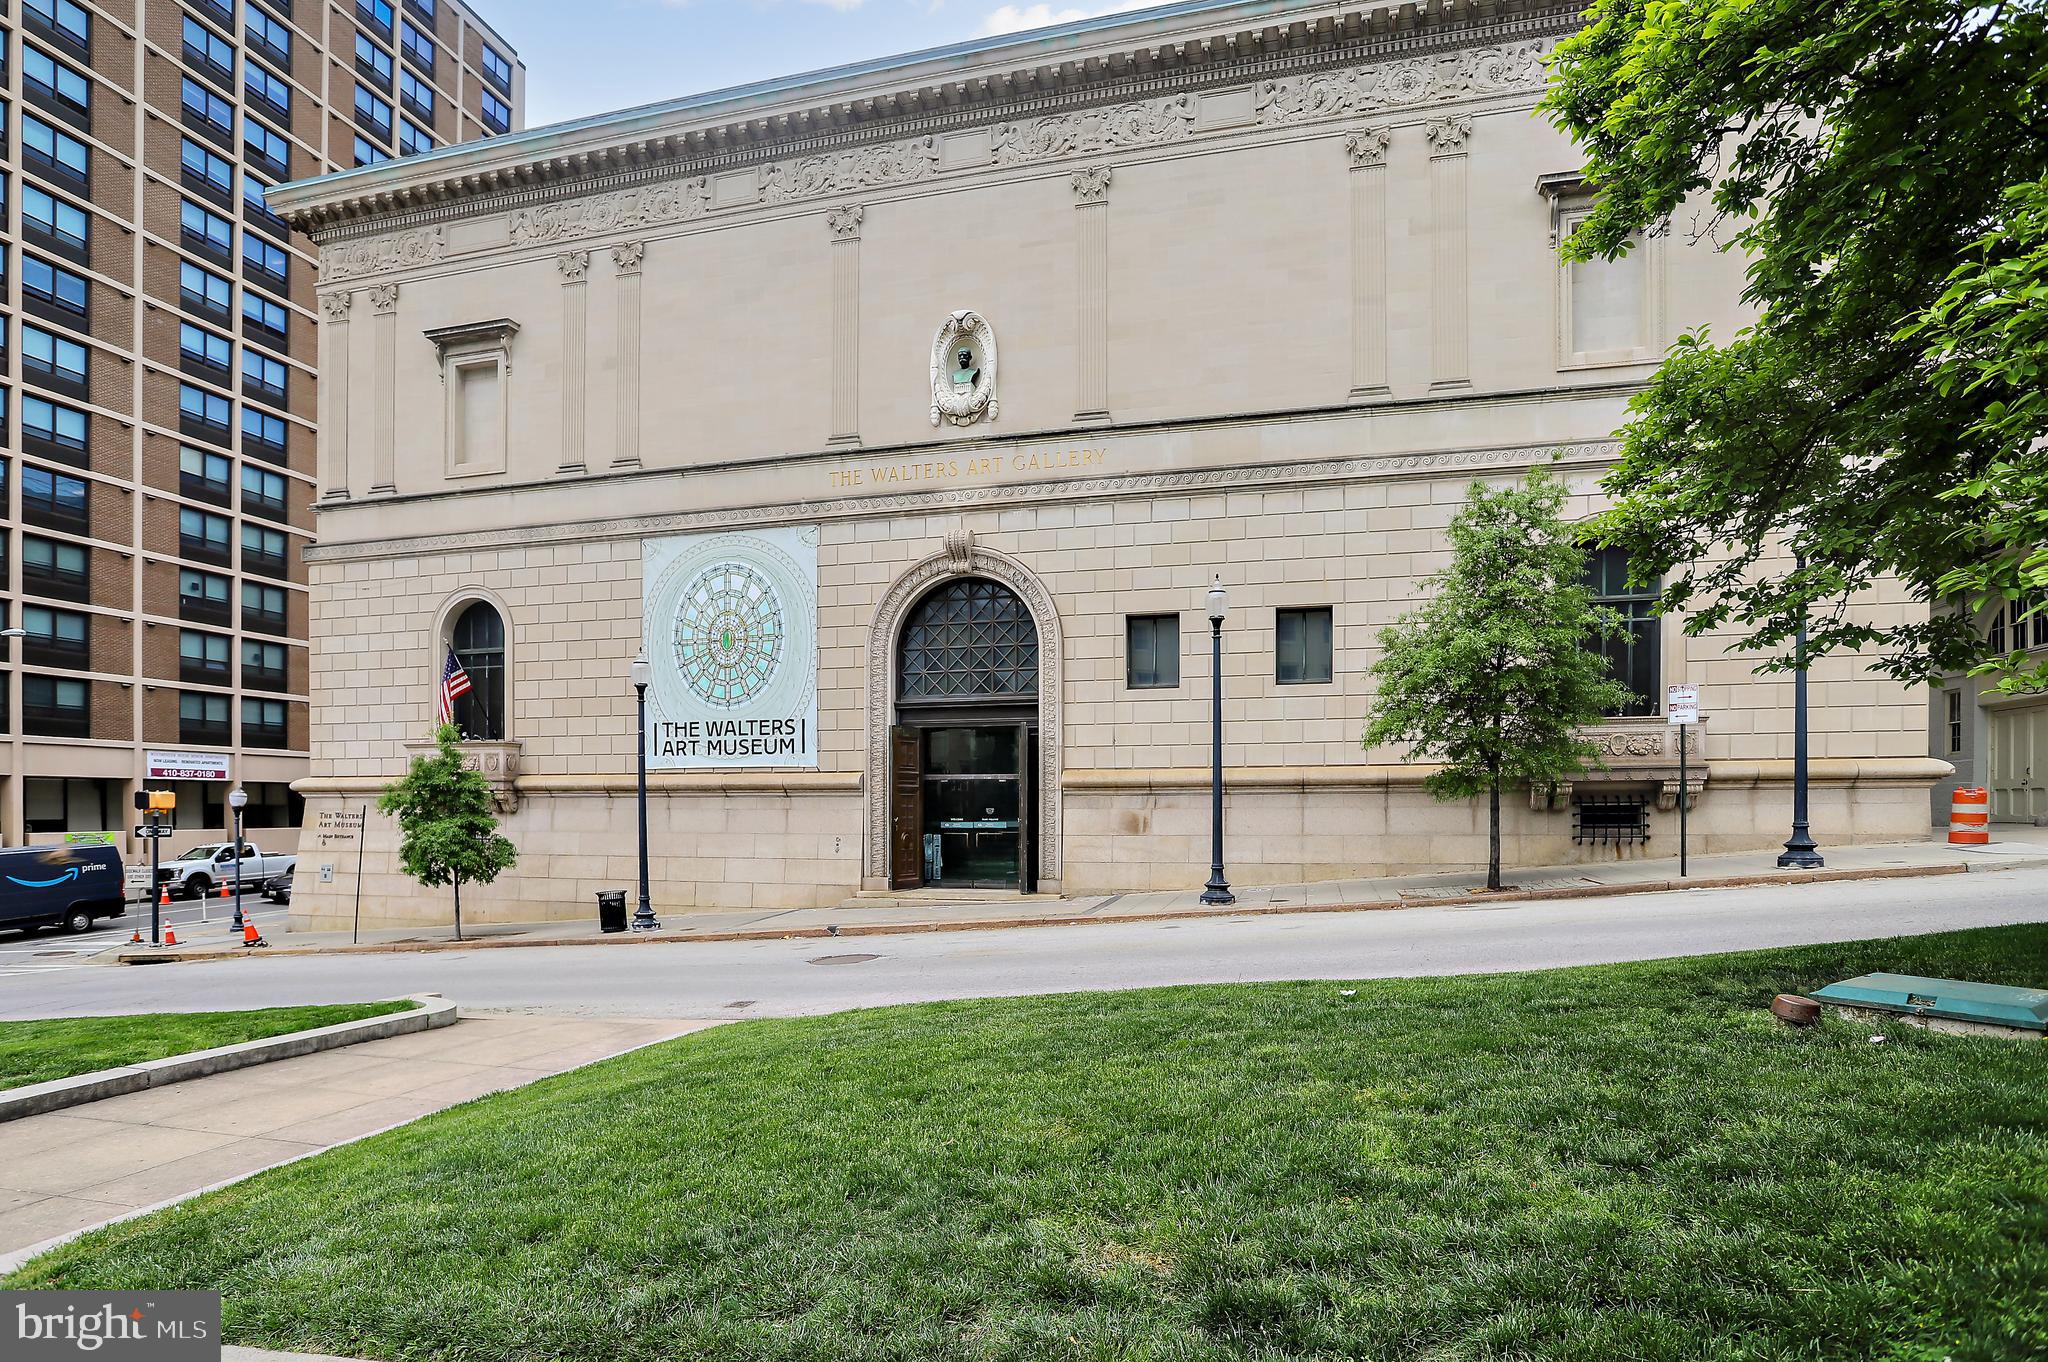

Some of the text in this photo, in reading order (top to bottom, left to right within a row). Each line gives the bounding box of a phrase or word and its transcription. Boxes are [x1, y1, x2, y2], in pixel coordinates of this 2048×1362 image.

[829, 448, 1107, 488] THE WALTERS ART GALLERY
[662, 719, 796, 738] THE WALTERS
[662, 738, 795, 756] ART MUSEUM
[162, 769, 216, 778] 410-837-0180
[82, 863, 107, 874] prime
